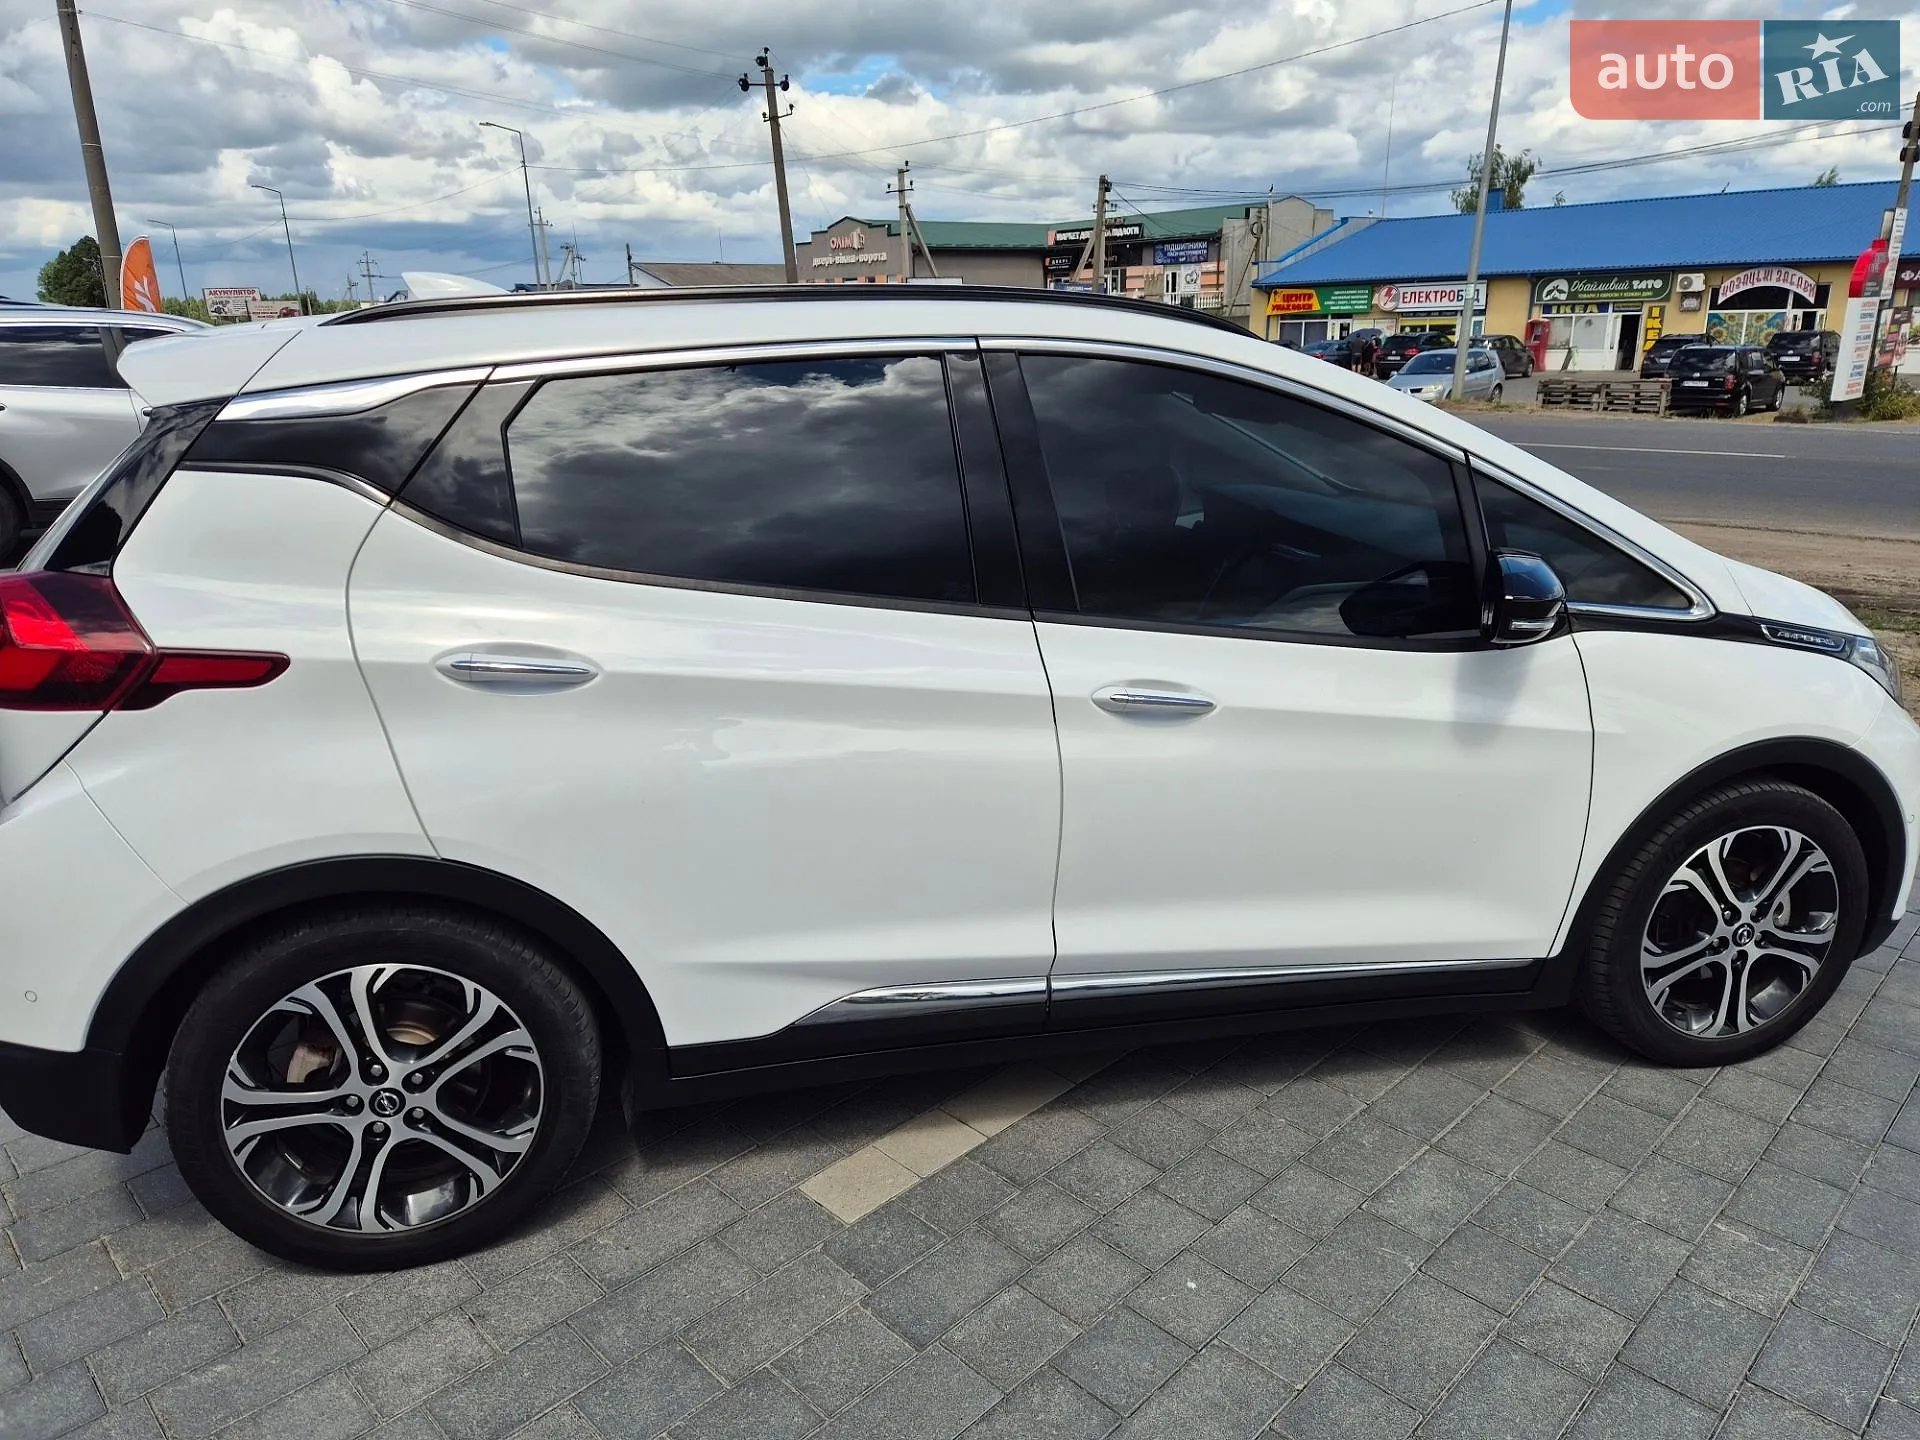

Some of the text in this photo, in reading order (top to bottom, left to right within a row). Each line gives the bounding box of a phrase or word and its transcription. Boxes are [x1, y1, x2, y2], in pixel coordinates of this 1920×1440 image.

[1164, 241, 1208, 251] ПІДШИПНИКИ
[1570, 276, 1663, 292] Дбайливий ТАТО
[1282, 293, 1313, 303] ЦЕНТР
[1402, 289, 1480, 304] ЕЛЕКТРОБД
[1271, 303, 1312, 312] УПАКОВКИ
[1551, 304, 1599, 314] IKEA
